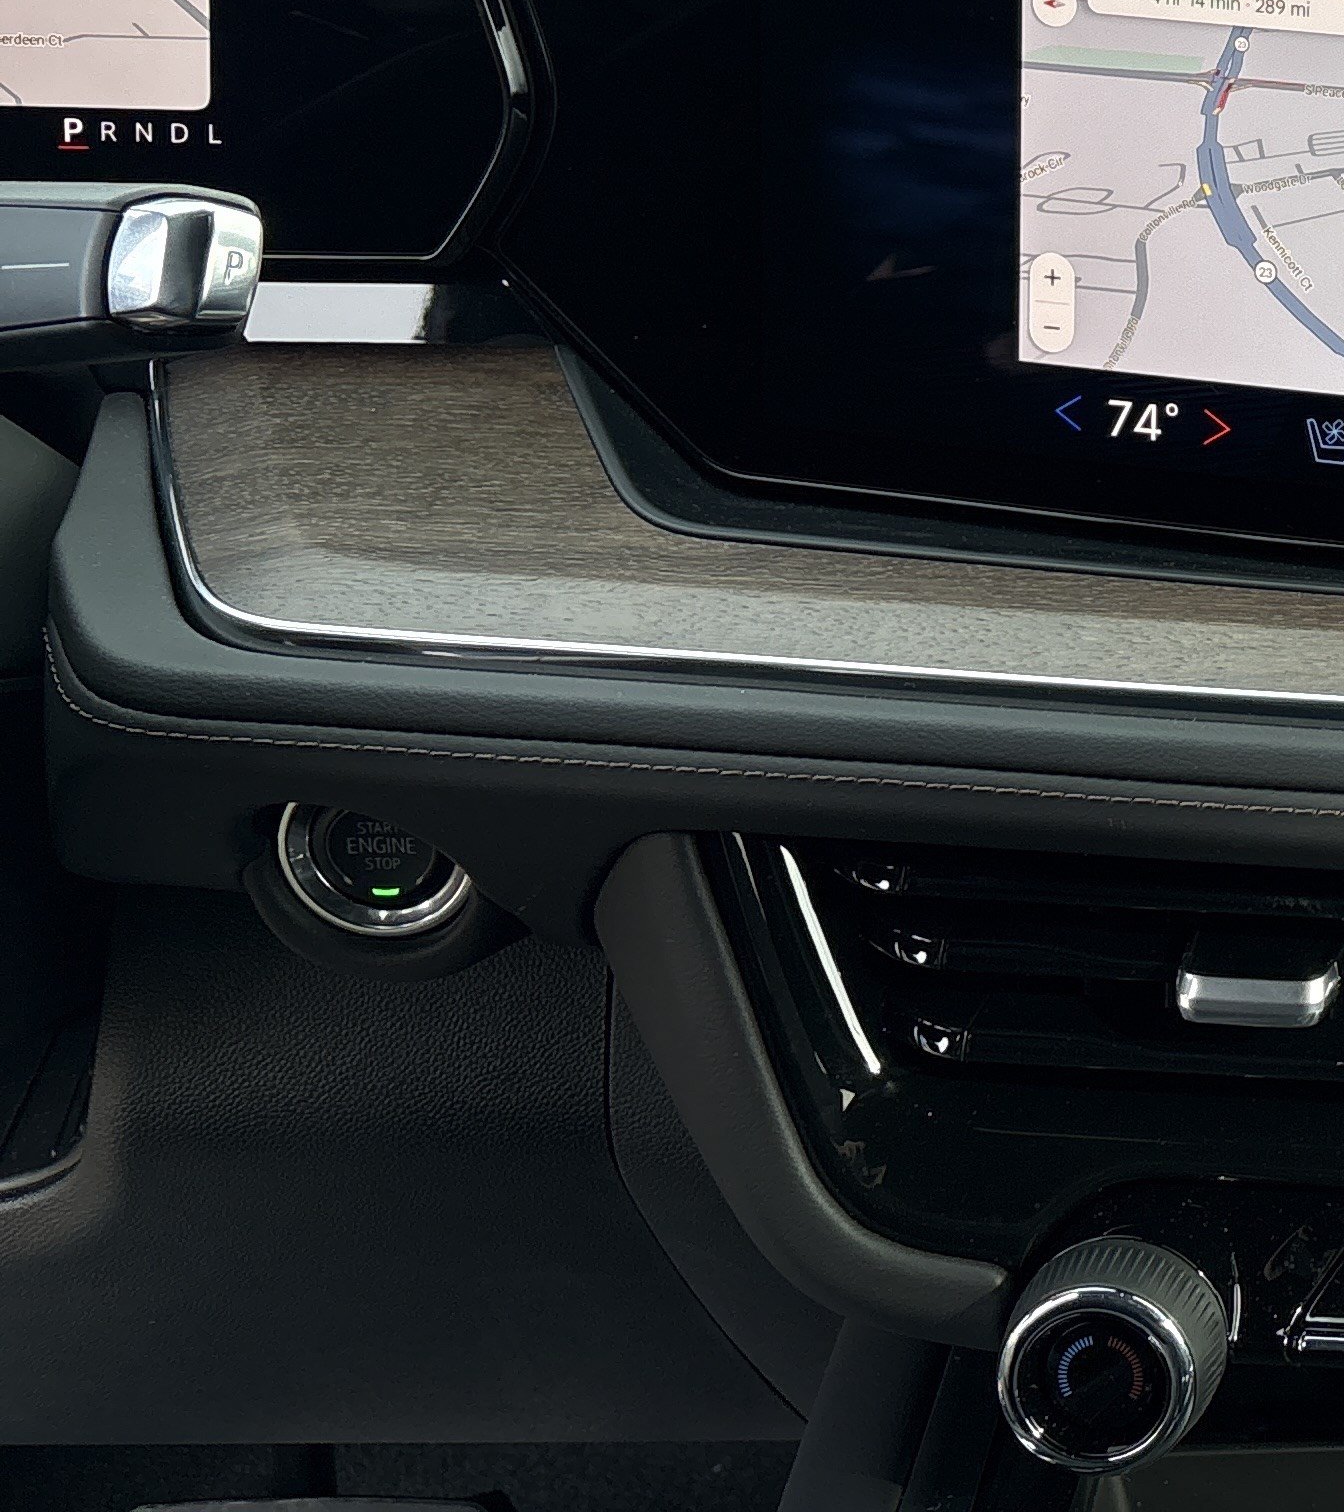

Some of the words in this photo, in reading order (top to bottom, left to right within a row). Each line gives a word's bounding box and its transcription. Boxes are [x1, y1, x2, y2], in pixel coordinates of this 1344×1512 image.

[1255, 0, 1286, 15] 289
[1291, 2, 1311, 18] mi
[49, 34, 63, 47] Ct
[63, 118, 83, 143] P
[101, 121, 117, 142] R
[136, 122, 152, 143] N
[171, 123, 189, 144] D
[208, 124, 222, 145] L
[1047, 156, 1064, 170] Cir
[1244, 177, 1297, 194] Woodgate
[1299, 174, 1311, 185] Dr
[1181, 197, 1197, 211] Rd
[224, 250, 244, 285] P
[1262, 226, 1303, 278] Kennicott
[1300, 275, 1314, 292] Ct
[1258, 267, 1273, 279] 23
[1108, 398, 1179, 442] 74°
[348, 836, 417, 855] ENGINE
[365, 857, 401, 871] STOP
